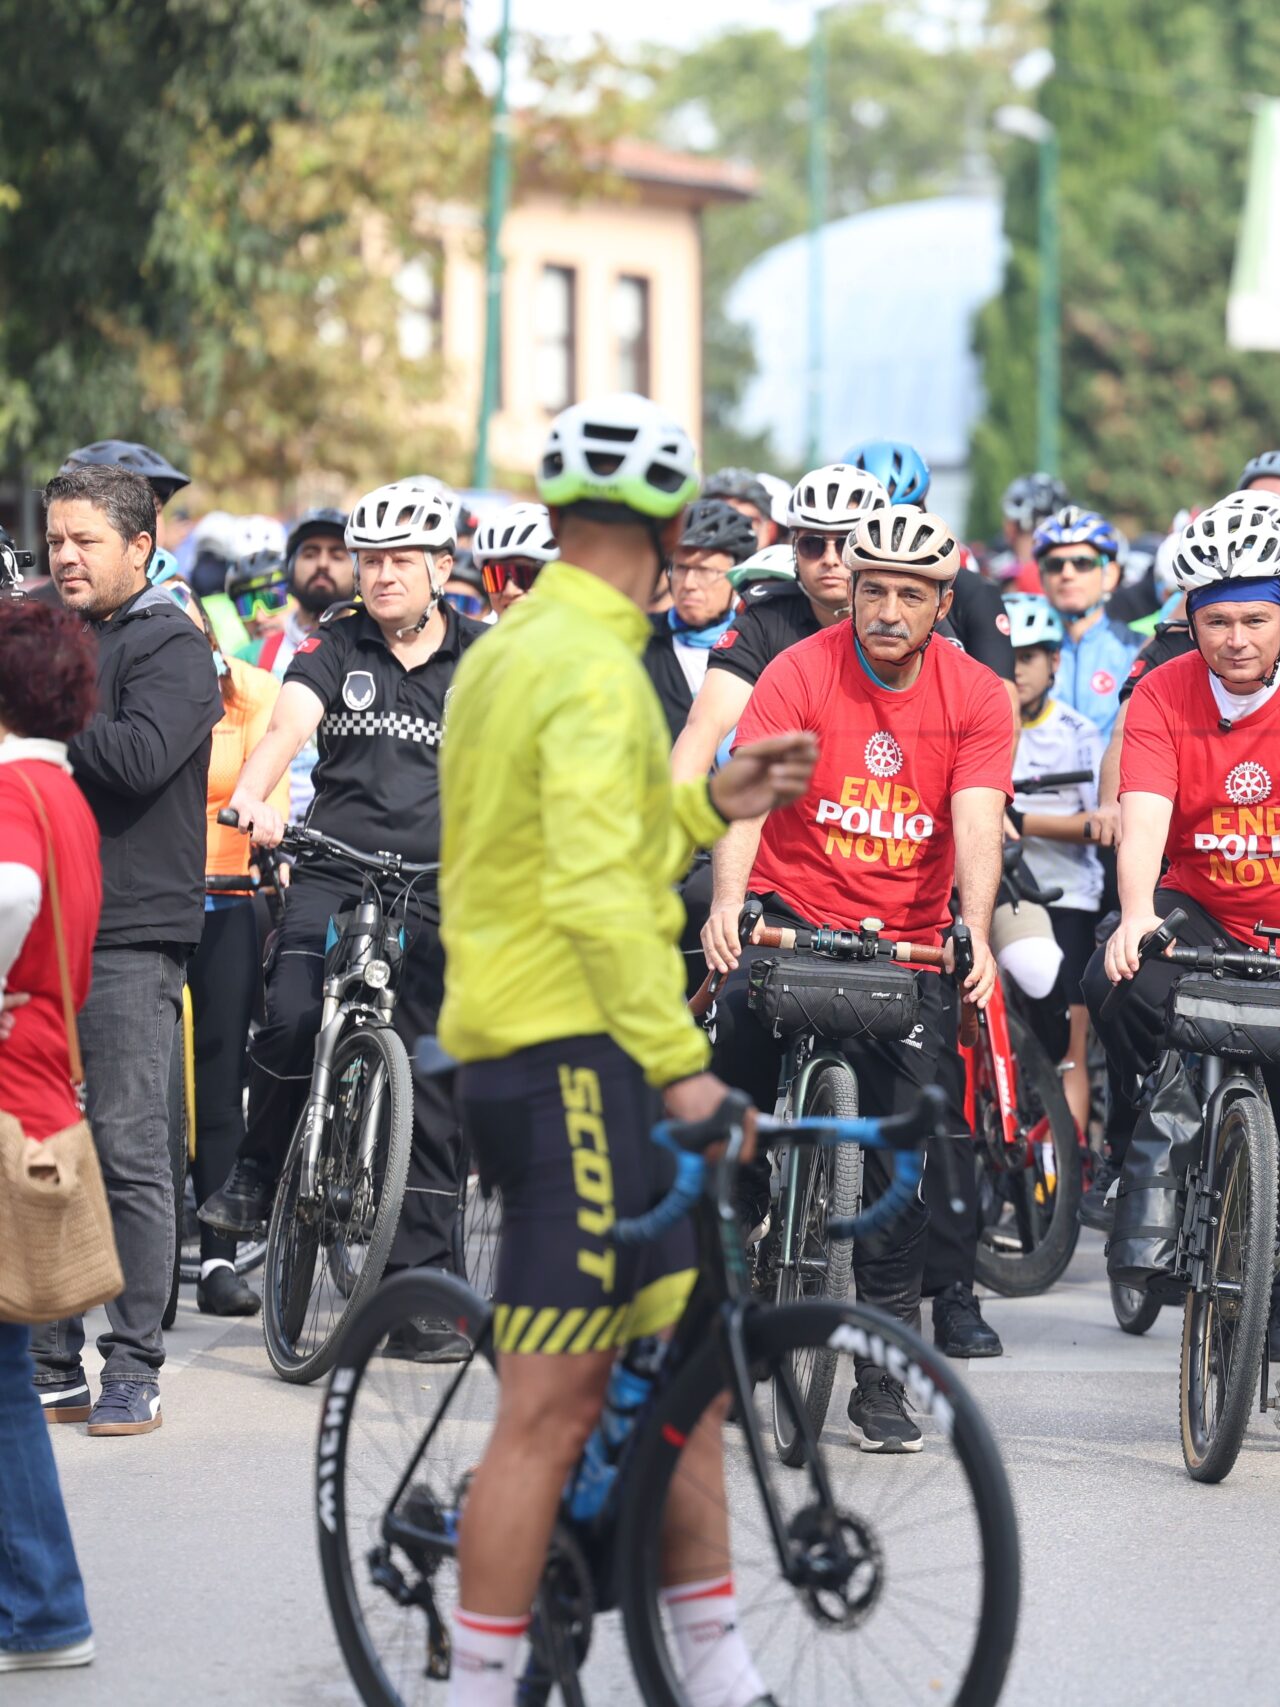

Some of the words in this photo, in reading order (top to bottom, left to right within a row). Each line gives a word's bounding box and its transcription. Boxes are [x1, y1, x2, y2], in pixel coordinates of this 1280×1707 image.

[840, 776, 920, 815] END
[816, 798, 934, 841] POLIO
[824, 827, 926, 867] NOW
[557, 1064, 616, 1293] SCOTT
[318, 1368, 356, 1534] MICHE
